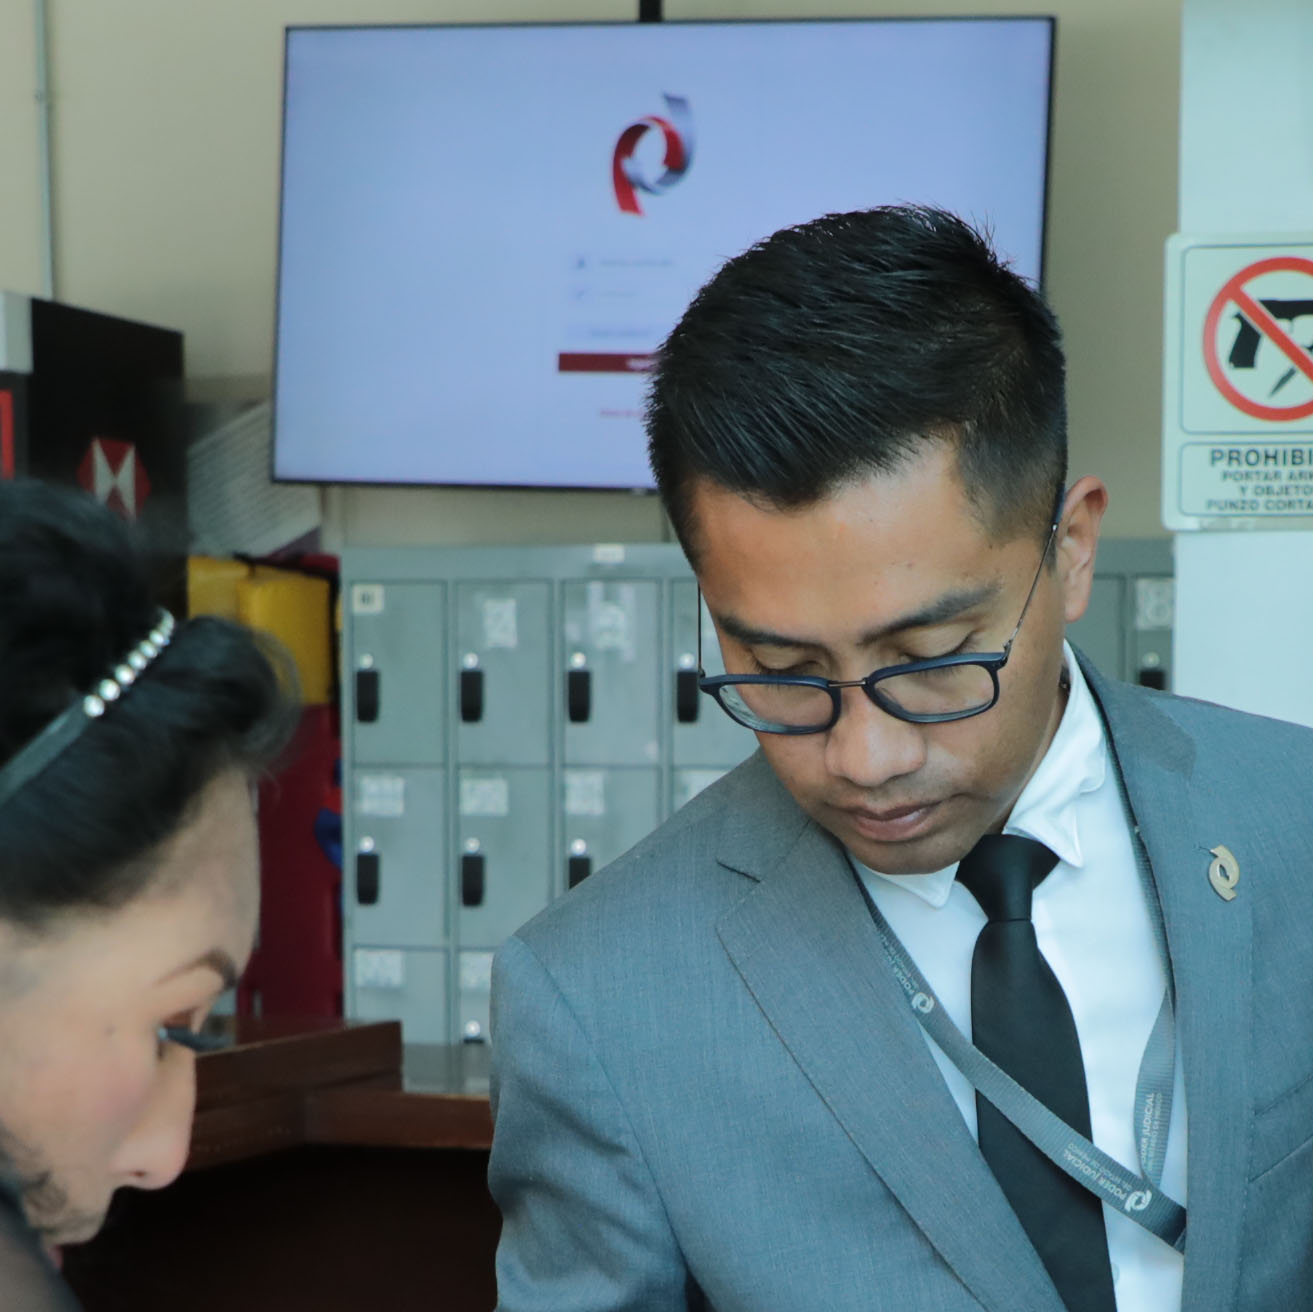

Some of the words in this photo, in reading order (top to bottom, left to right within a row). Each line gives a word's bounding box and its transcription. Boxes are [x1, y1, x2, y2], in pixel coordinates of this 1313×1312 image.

[1221, 470, 1282, 482] PORTAR
[1240, 486, 1248, 496] Y
[1206, 499, 1259, 512] PUNZO
